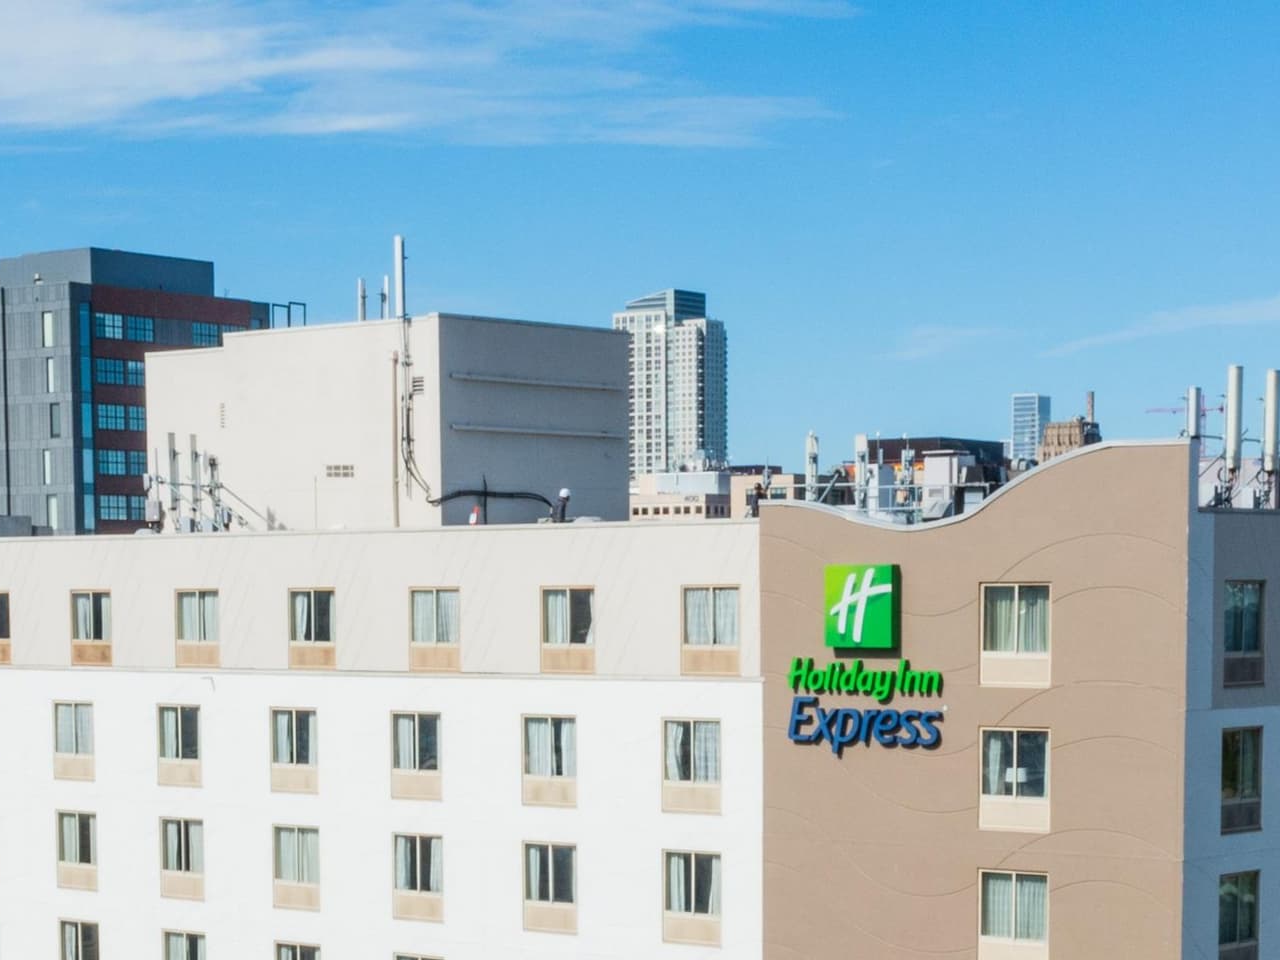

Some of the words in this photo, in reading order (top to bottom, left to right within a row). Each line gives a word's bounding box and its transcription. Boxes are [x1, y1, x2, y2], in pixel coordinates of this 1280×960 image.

[787, 656, 896, 701] Holiday
[895, 658, 940, 693] Inn
[787, 696, 940, 754] Express
